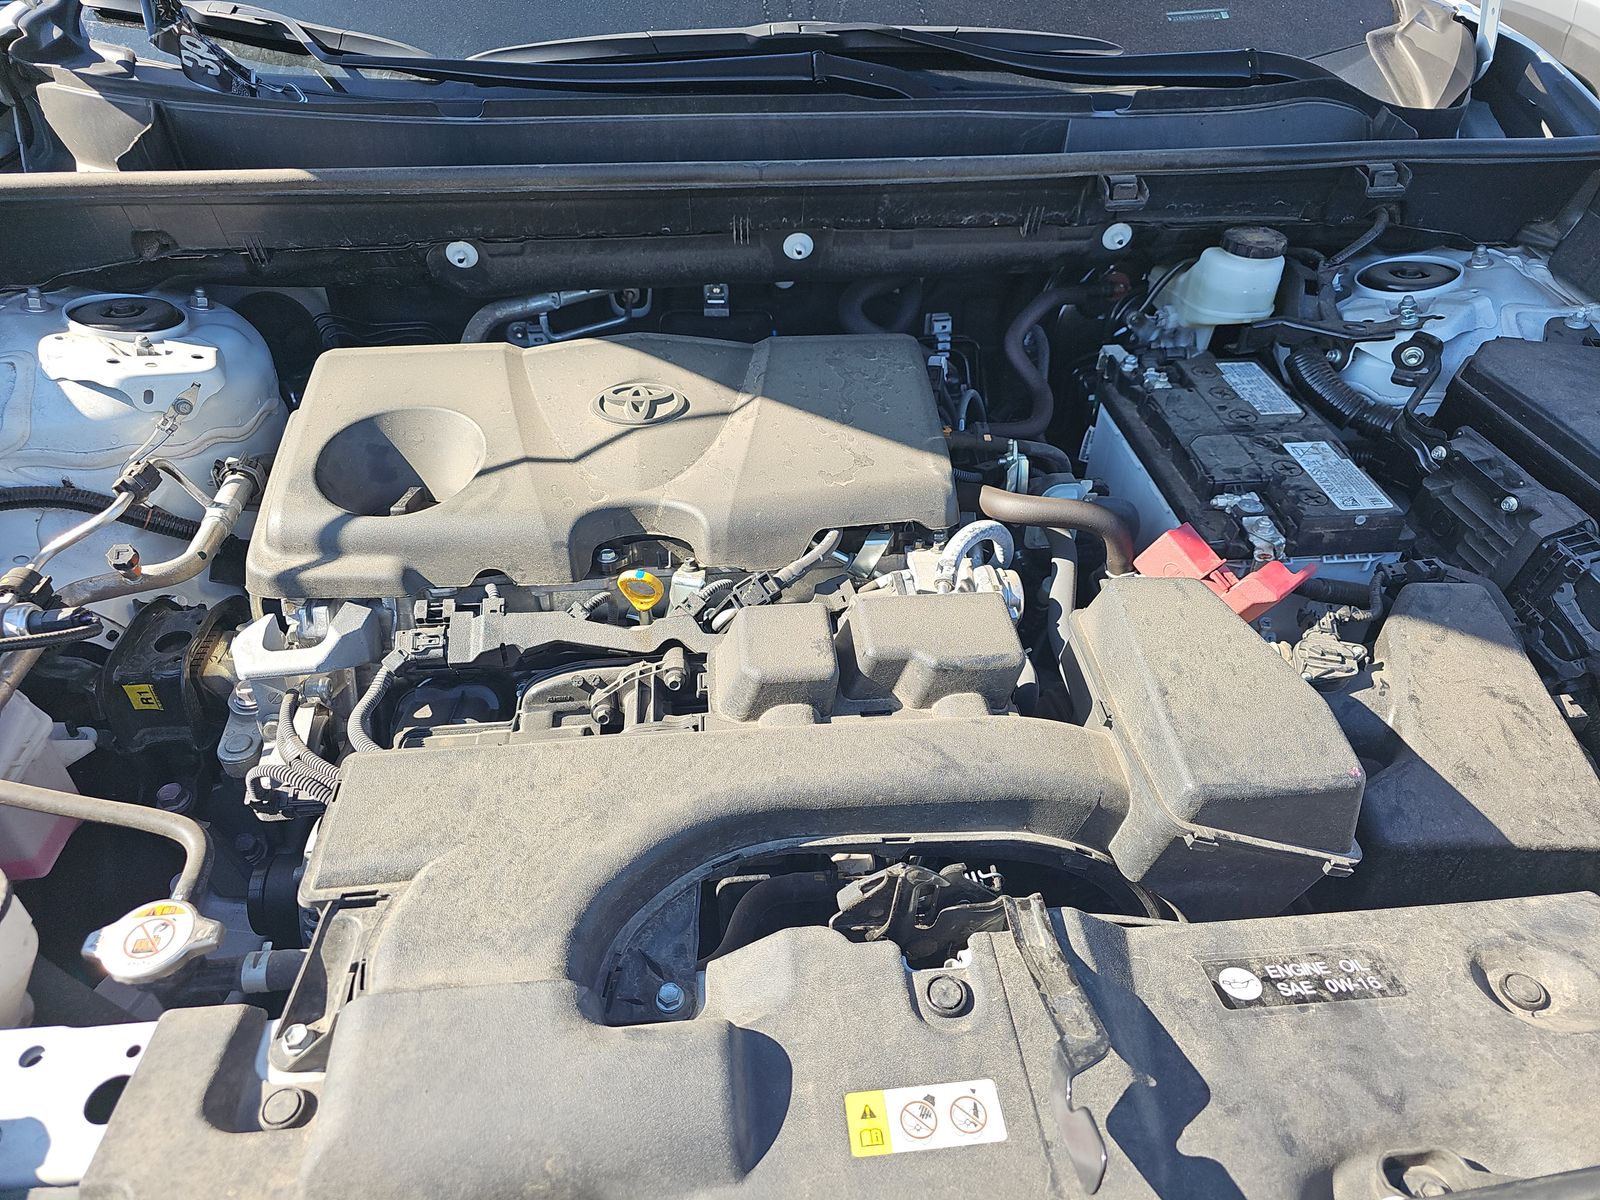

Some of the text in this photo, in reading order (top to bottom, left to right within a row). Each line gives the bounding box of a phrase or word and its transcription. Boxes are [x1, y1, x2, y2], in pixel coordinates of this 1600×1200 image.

[136, 691, 155, 705] R1
[1264, 958, 1371, 979] ENGINE OIL
[1276, 975, 1382, 997] SAE 0W-16
